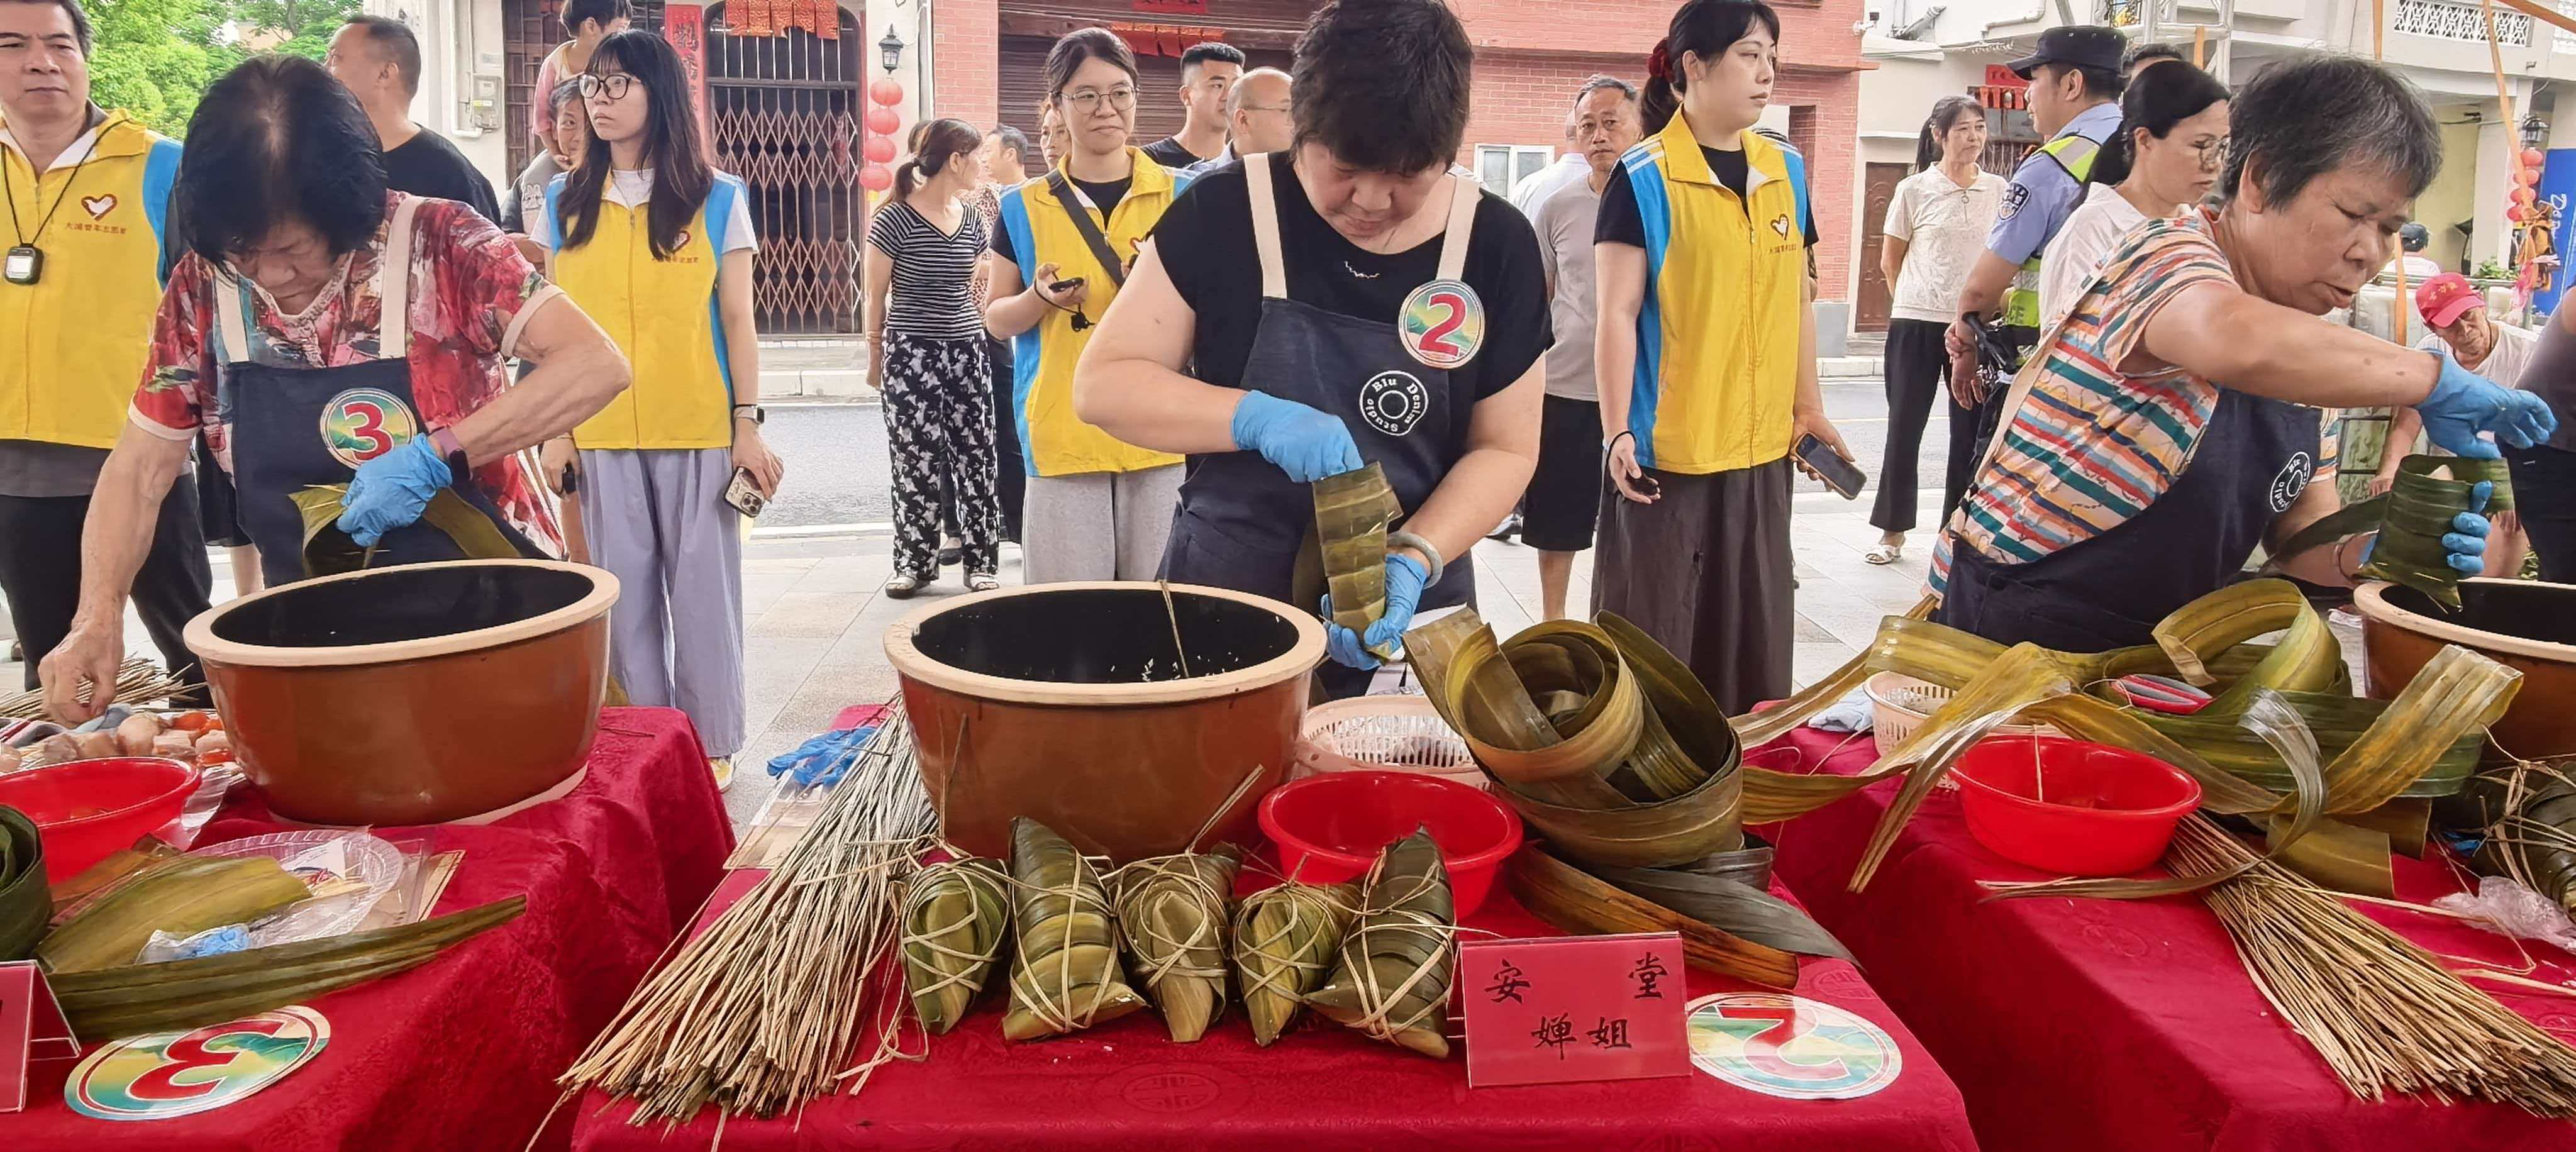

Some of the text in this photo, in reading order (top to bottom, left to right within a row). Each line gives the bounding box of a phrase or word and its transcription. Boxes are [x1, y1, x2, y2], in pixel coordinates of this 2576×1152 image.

[1418, 292, 1467, 358] 2
[341, 401, 394, 462] 3
[1365, 378, 1421, 432] Blu Denim Studio
[125, 1019, 289, 1101] 3
[1714, 1005, 1852, 1082] 2
